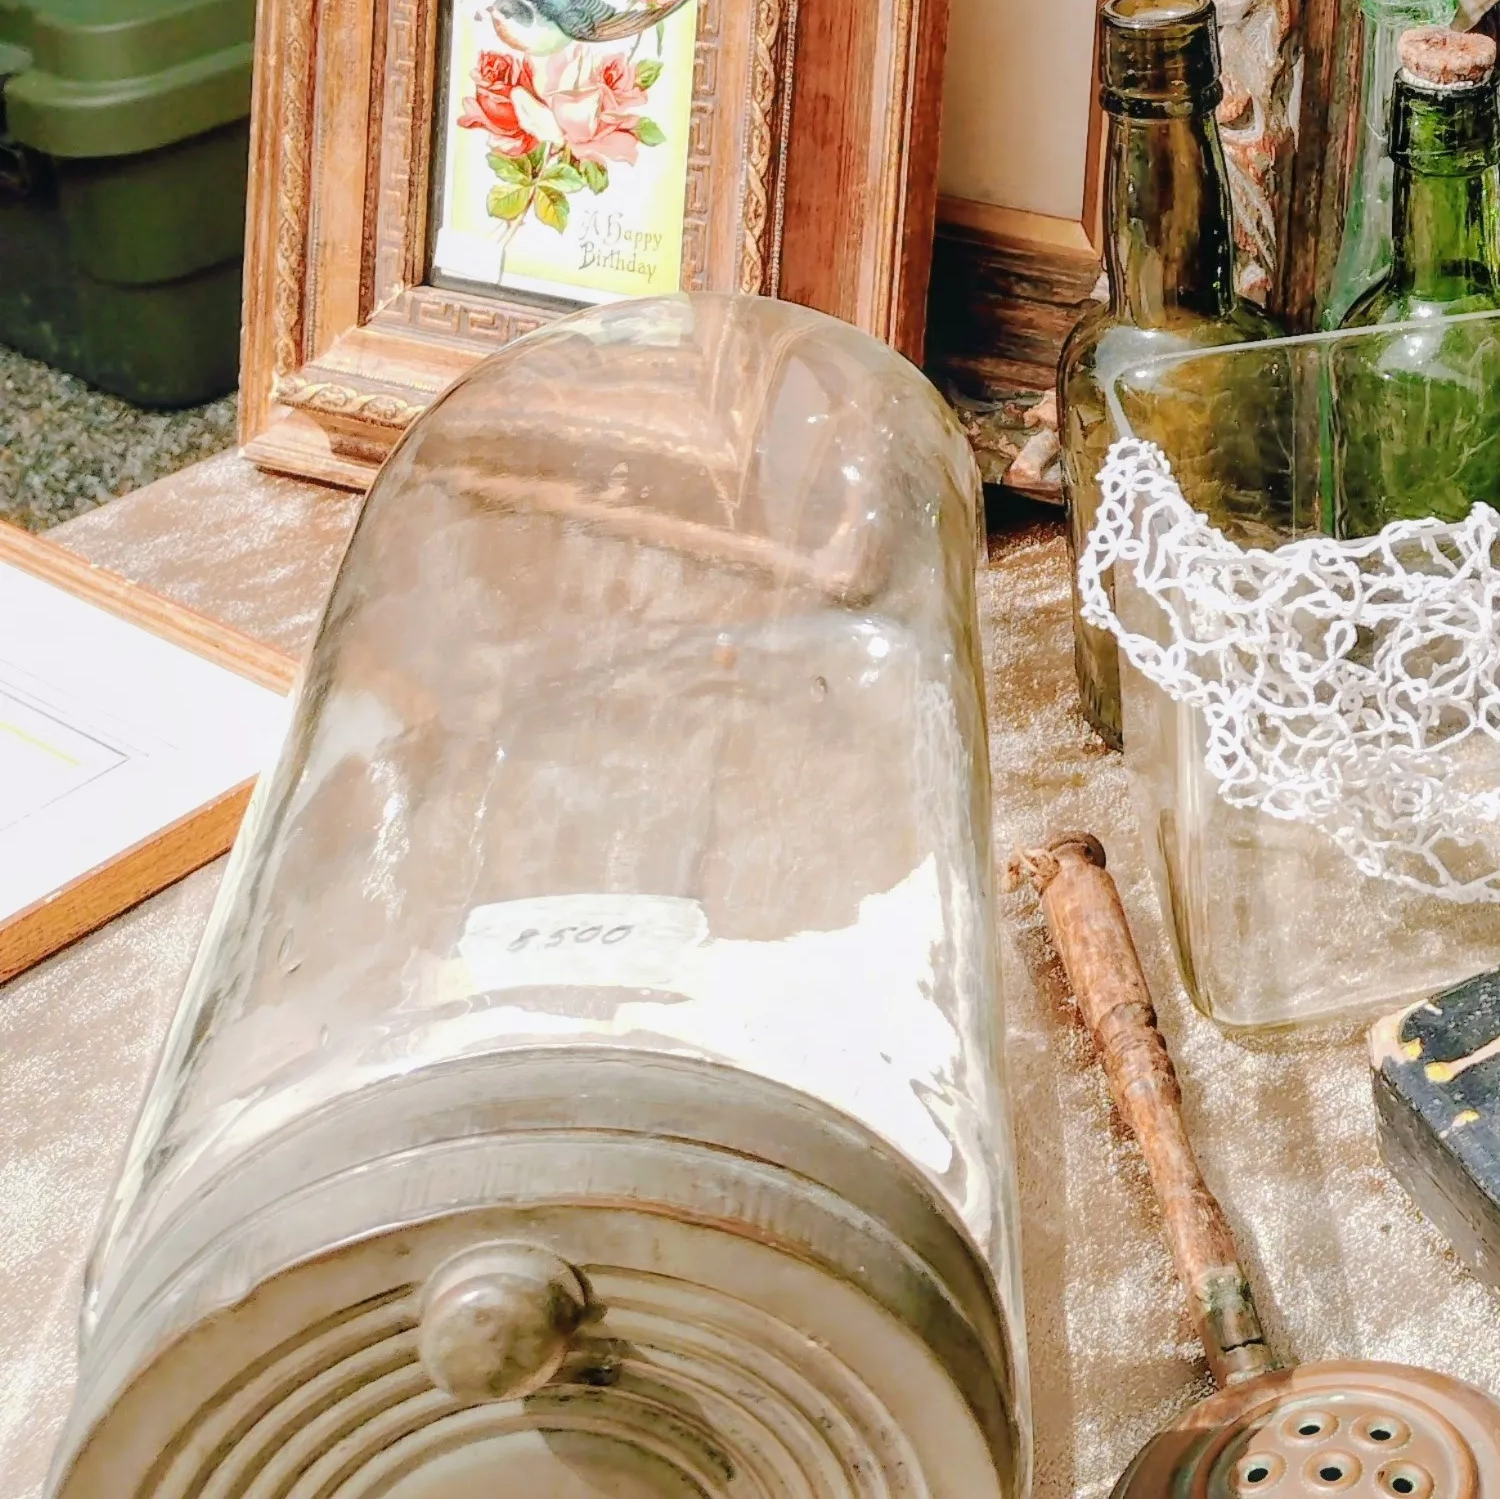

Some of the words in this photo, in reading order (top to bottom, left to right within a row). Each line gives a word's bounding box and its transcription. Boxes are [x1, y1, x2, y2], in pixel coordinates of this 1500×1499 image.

[578, 209, 599, 241] A
[602, 211, 662, 252] Happy
[578, 240, 657, 284] Birthday
